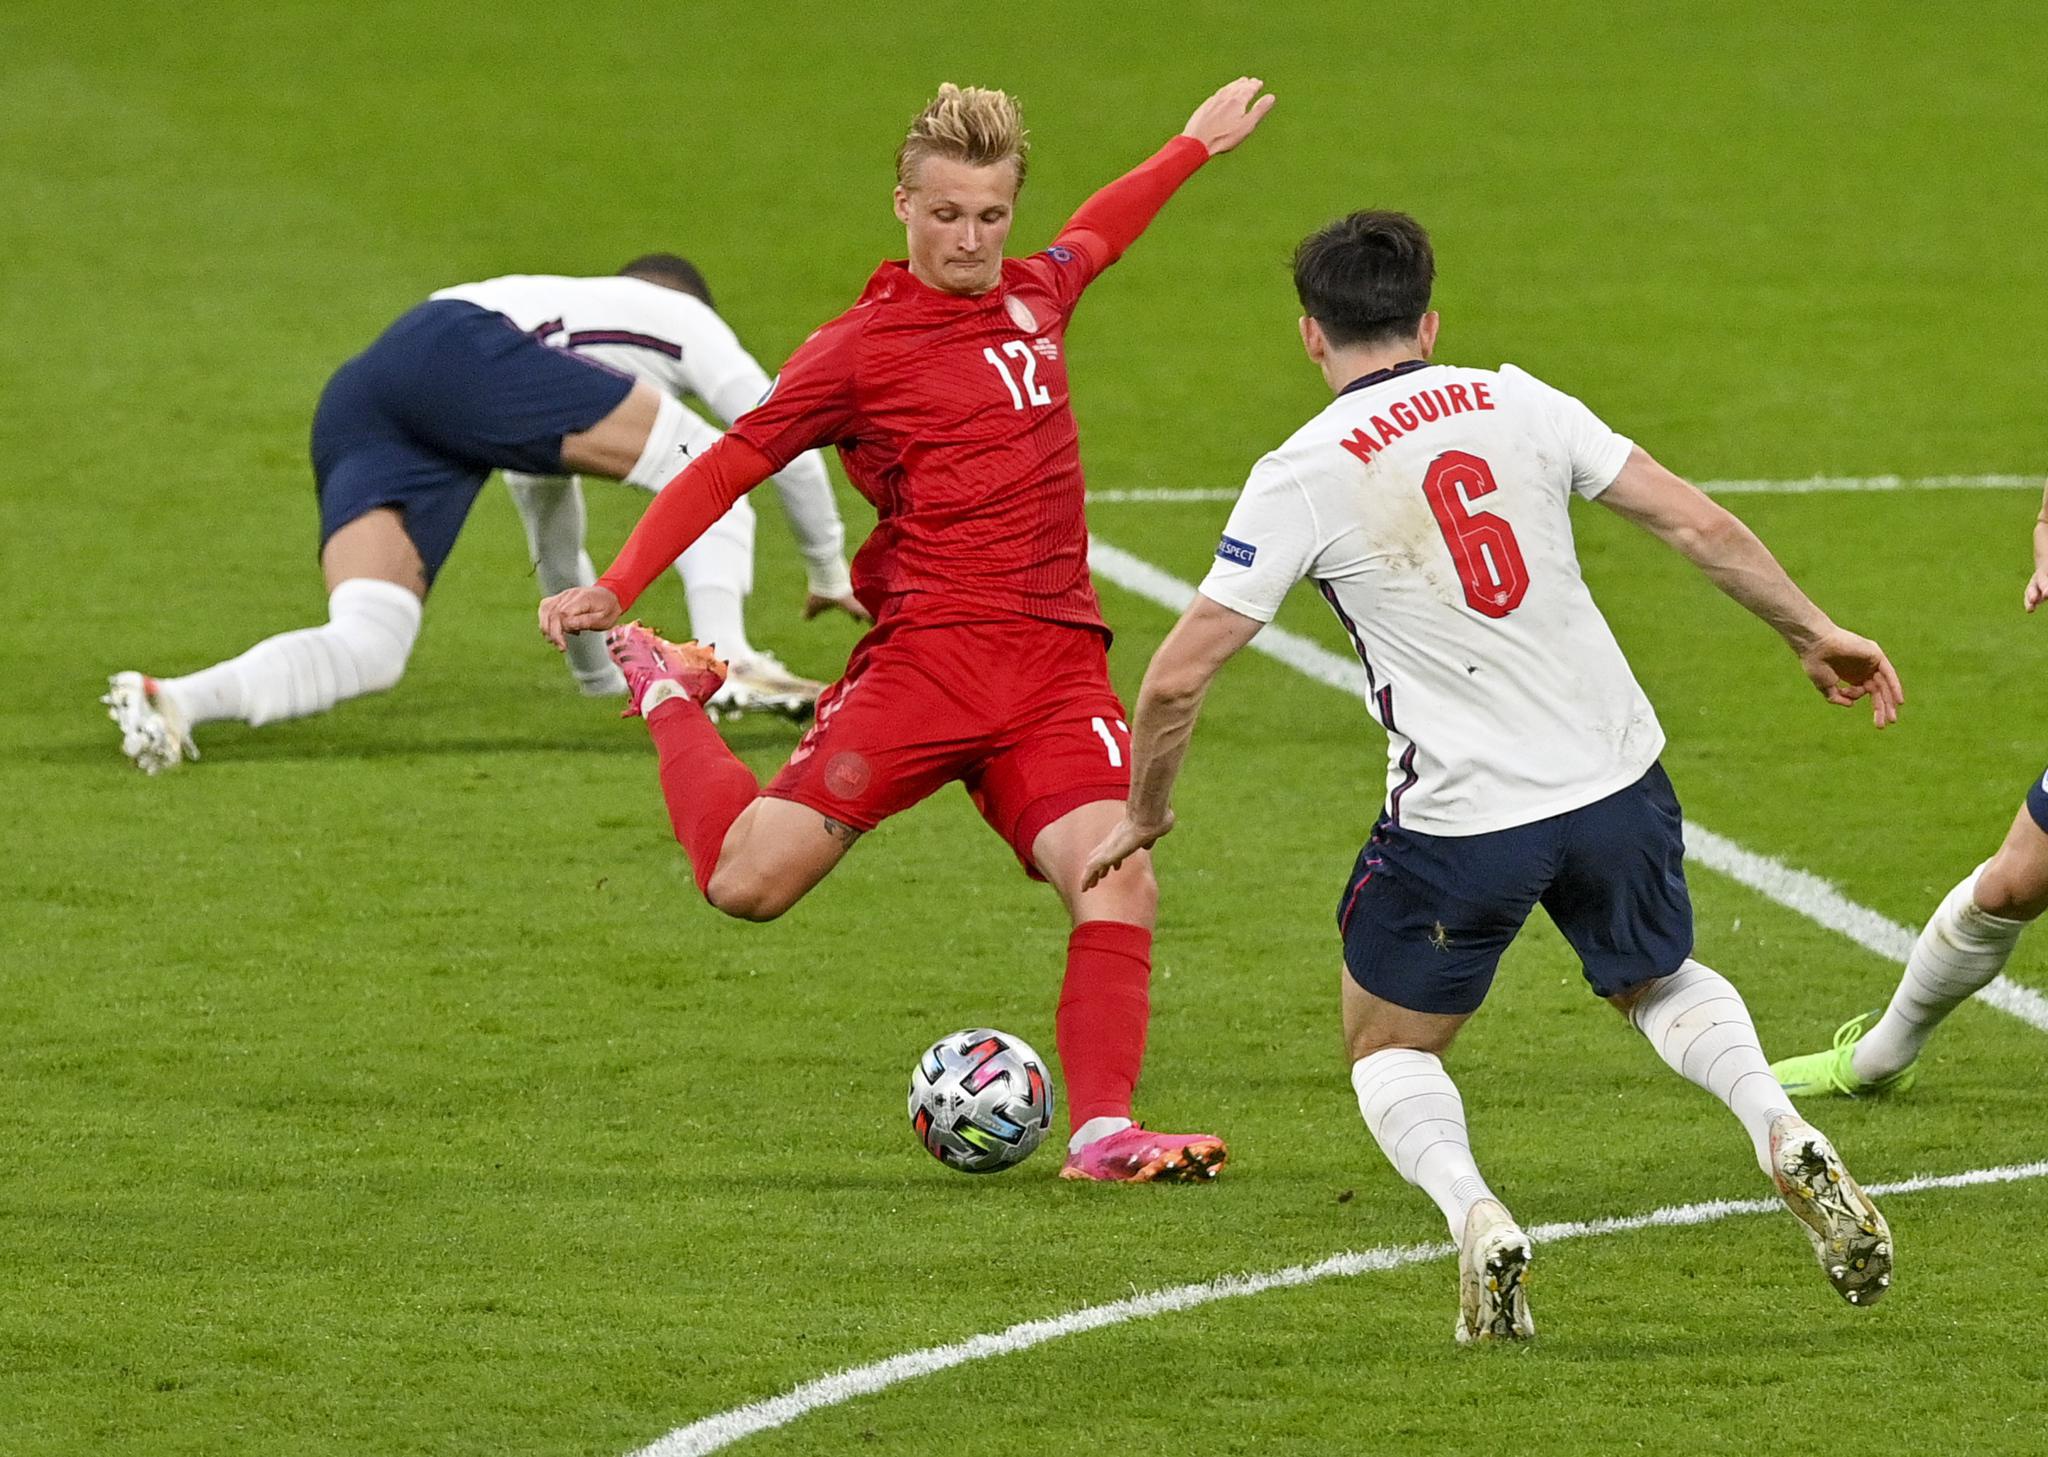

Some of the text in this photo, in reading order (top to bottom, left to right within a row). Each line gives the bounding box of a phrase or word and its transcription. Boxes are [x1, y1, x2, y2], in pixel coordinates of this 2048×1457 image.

[983, 340, 1051, 410] 12
[1339, 382, 1495, 464] MAGUIRE
[1422, 450, 1530, 619] 6
[1091, 716, 1129, 767] 1
